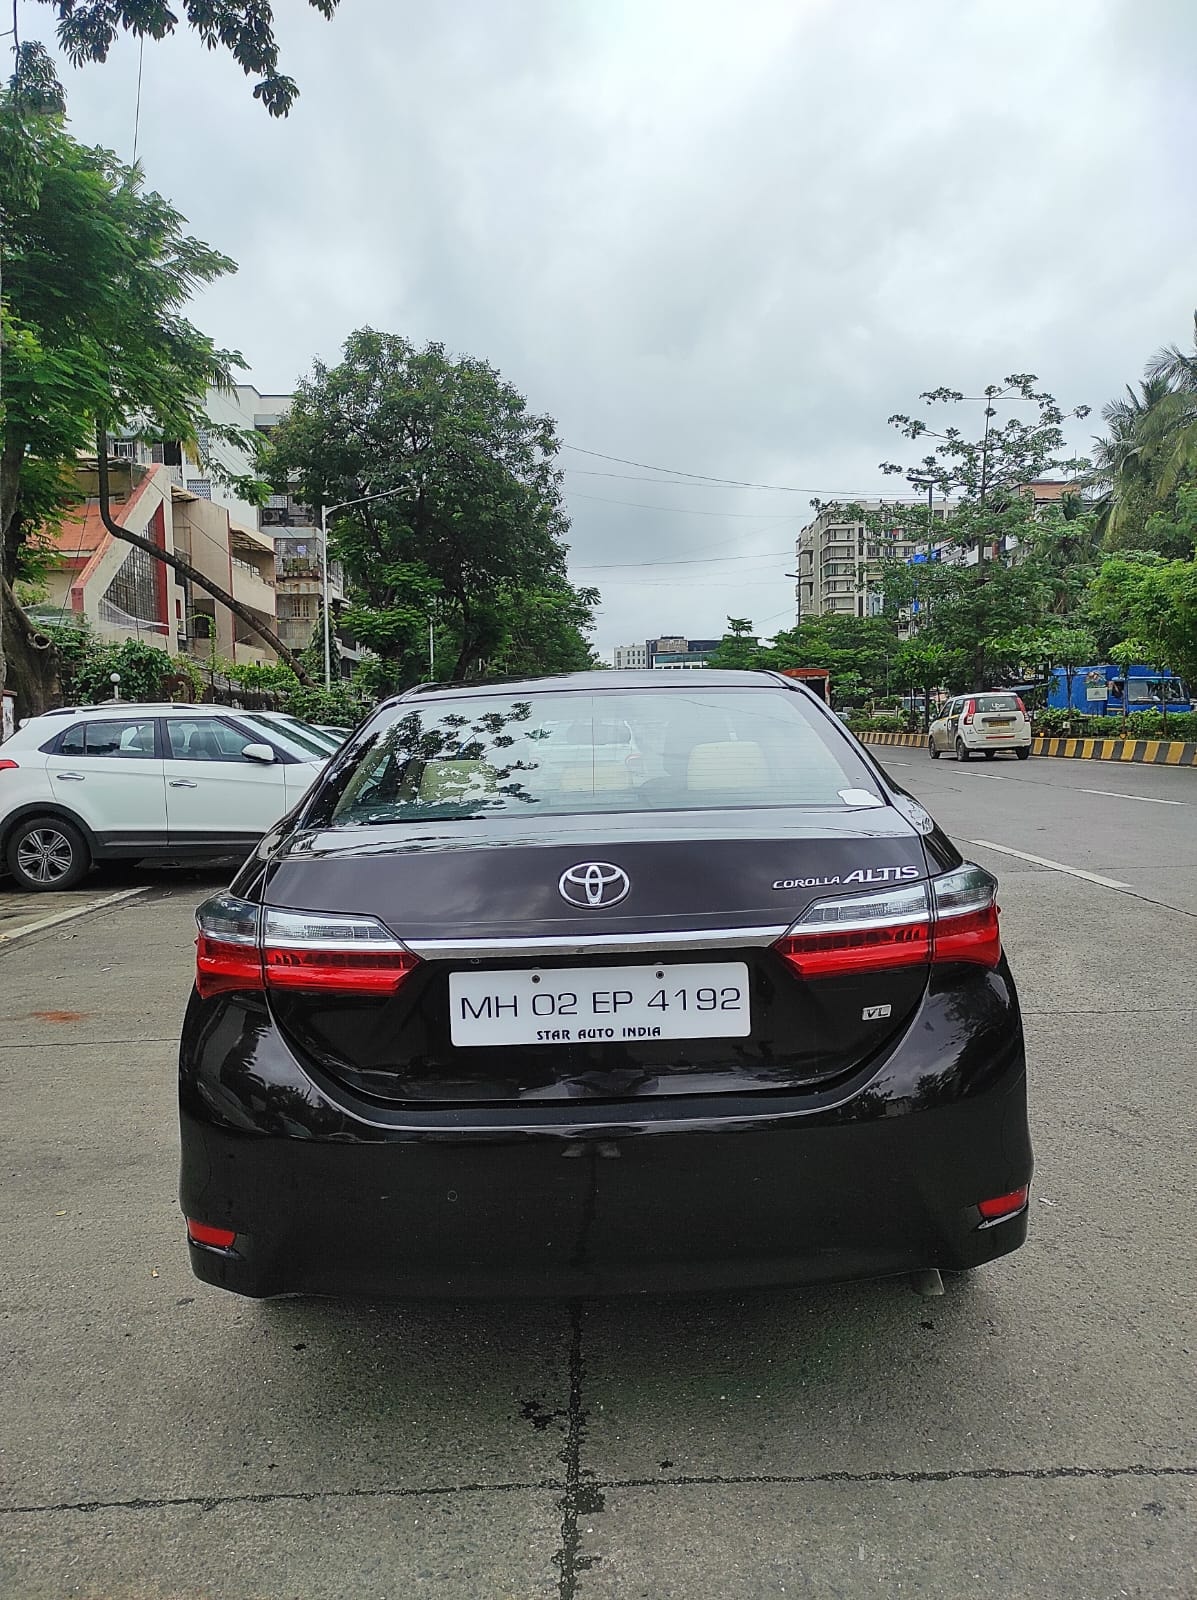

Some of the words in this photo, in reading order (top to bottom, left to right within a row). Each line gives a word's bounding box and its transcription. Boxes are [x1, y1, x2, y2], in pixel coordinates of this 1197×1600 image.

[772, 876, 840, 889] COROLLA
[842, 865, 920, 884] ALTIS
[460, 995, 518, 1019] MH
[531, 992, 578, 1016] 02
[592, 990, 633, 1014] EP
[647, 987, 742, 1012] 4192
[866, 1006, 890, 1018] VL
[536, 1029, 571, 1041] STAR
[578, 1027, 614, 1039] AUTO
[622, 1026, 662, 1038] INDIA
